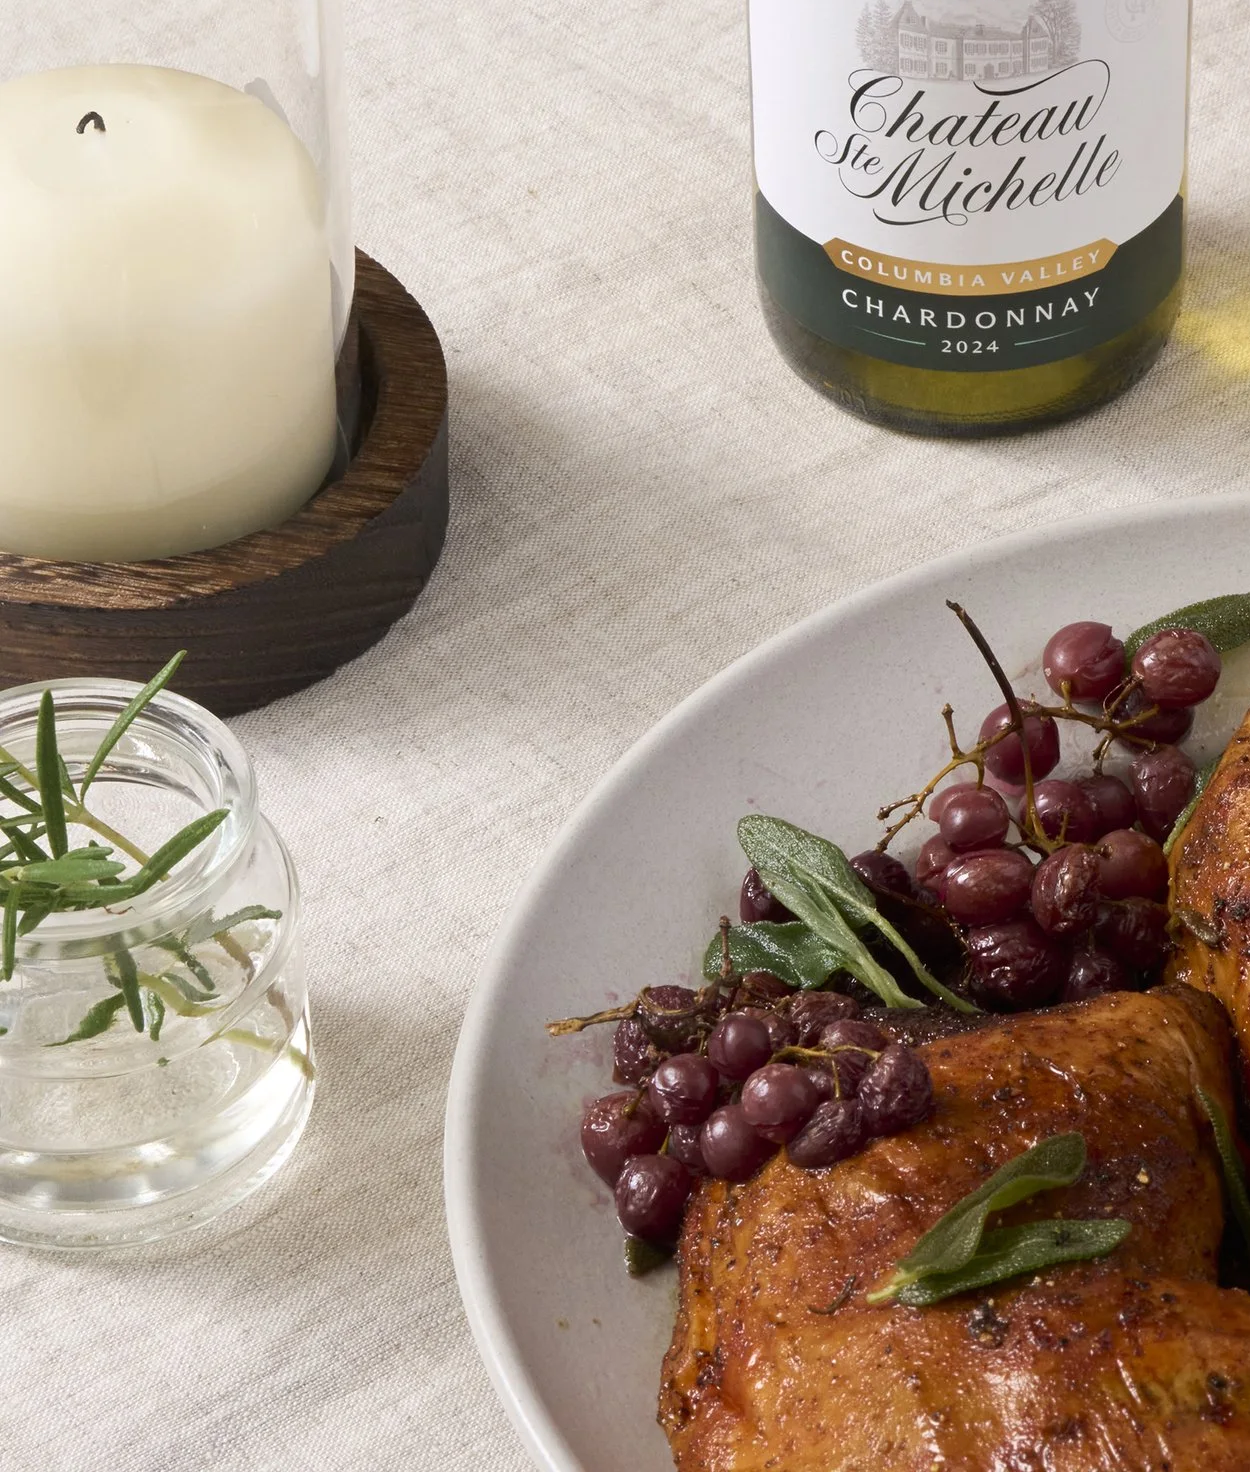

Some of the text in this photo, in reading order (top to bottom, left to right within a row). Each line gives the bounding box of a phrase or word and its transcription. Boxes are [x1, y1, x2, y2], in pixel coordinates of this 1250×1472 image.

[848, 59, 1110, 146] Chateau
[814, 130, 1122, 226] Ste Michelle
[841, 250, 1101, 287] COLUMBIA VALLEY
[842, 287, 1101, 329] CHARDONNAY
[941, 339, 1000, 354] 2024
